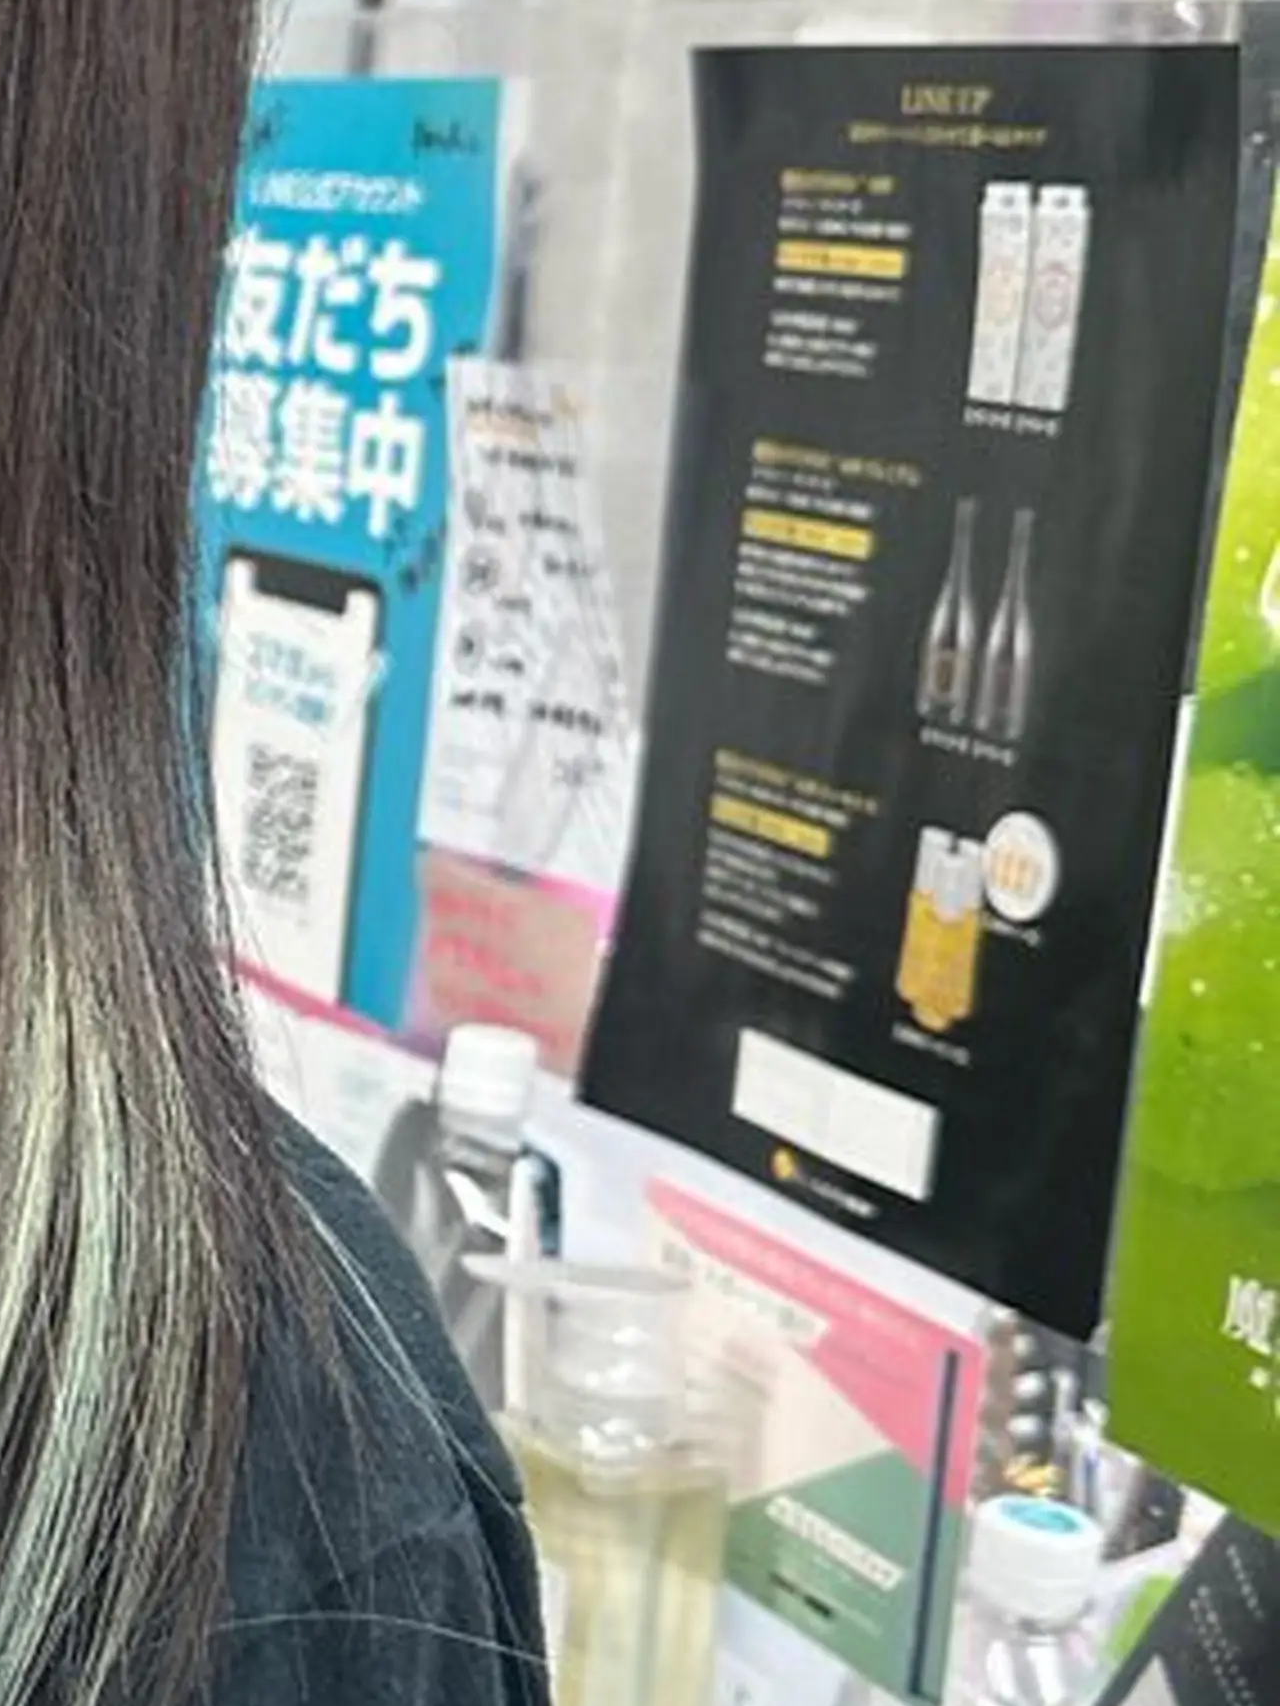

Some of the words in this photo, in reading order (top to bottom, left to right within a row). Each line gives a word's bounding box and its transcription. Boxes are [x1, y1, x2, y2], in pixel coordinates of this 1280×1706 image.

[222, 223, 440, 383] 友だち
[207, 369, 424, 538] 募集中
